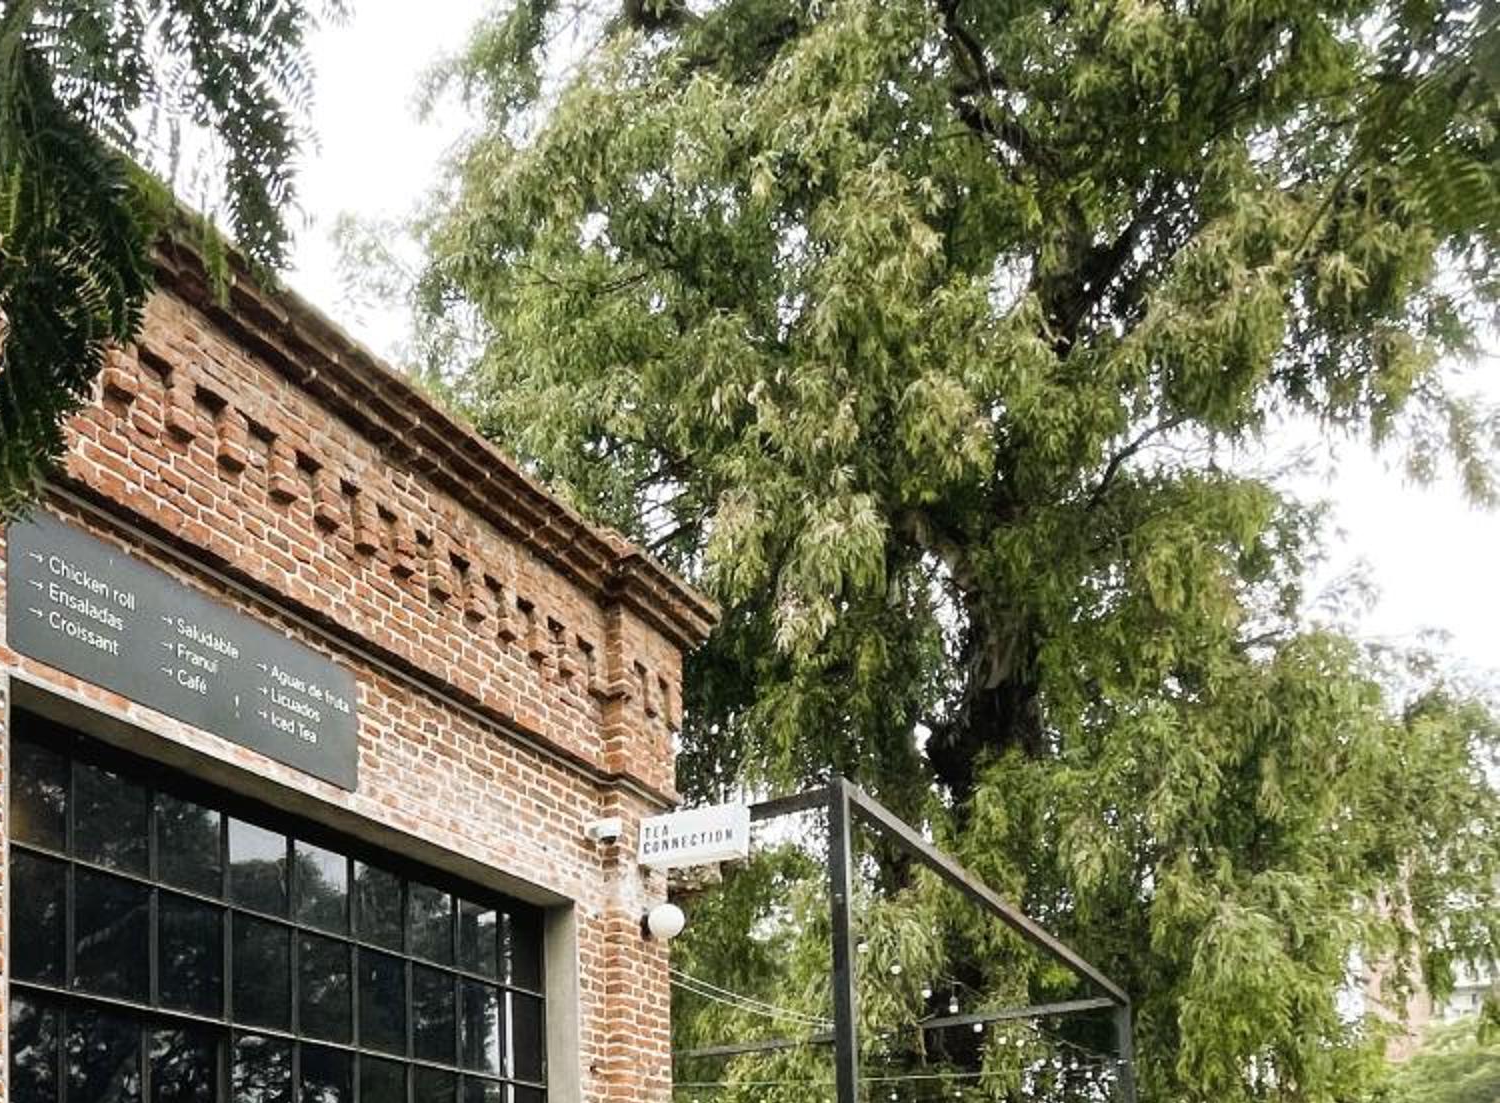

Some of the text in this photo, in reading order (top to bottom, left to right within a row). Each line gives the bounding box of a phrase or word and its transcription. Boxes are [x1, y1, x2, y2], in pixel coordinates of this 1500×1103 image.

[49, 556, 136, 610] Chicken roll
[49, 583, 124, 631] Ensaladas
[49, 611, 120, 656] Croissant
[177, 618, 239, 660] Saludable
[177, 669, 207, 695] Café
[271, 665, 350, 714] Aguas de fruta
[271, 687, 321, 722] Licuados
[271, 711, 317, 743] Iced Tea
[643, 828, 733, 854] CONNECTION
[645, 825, 669, 839] TEA
